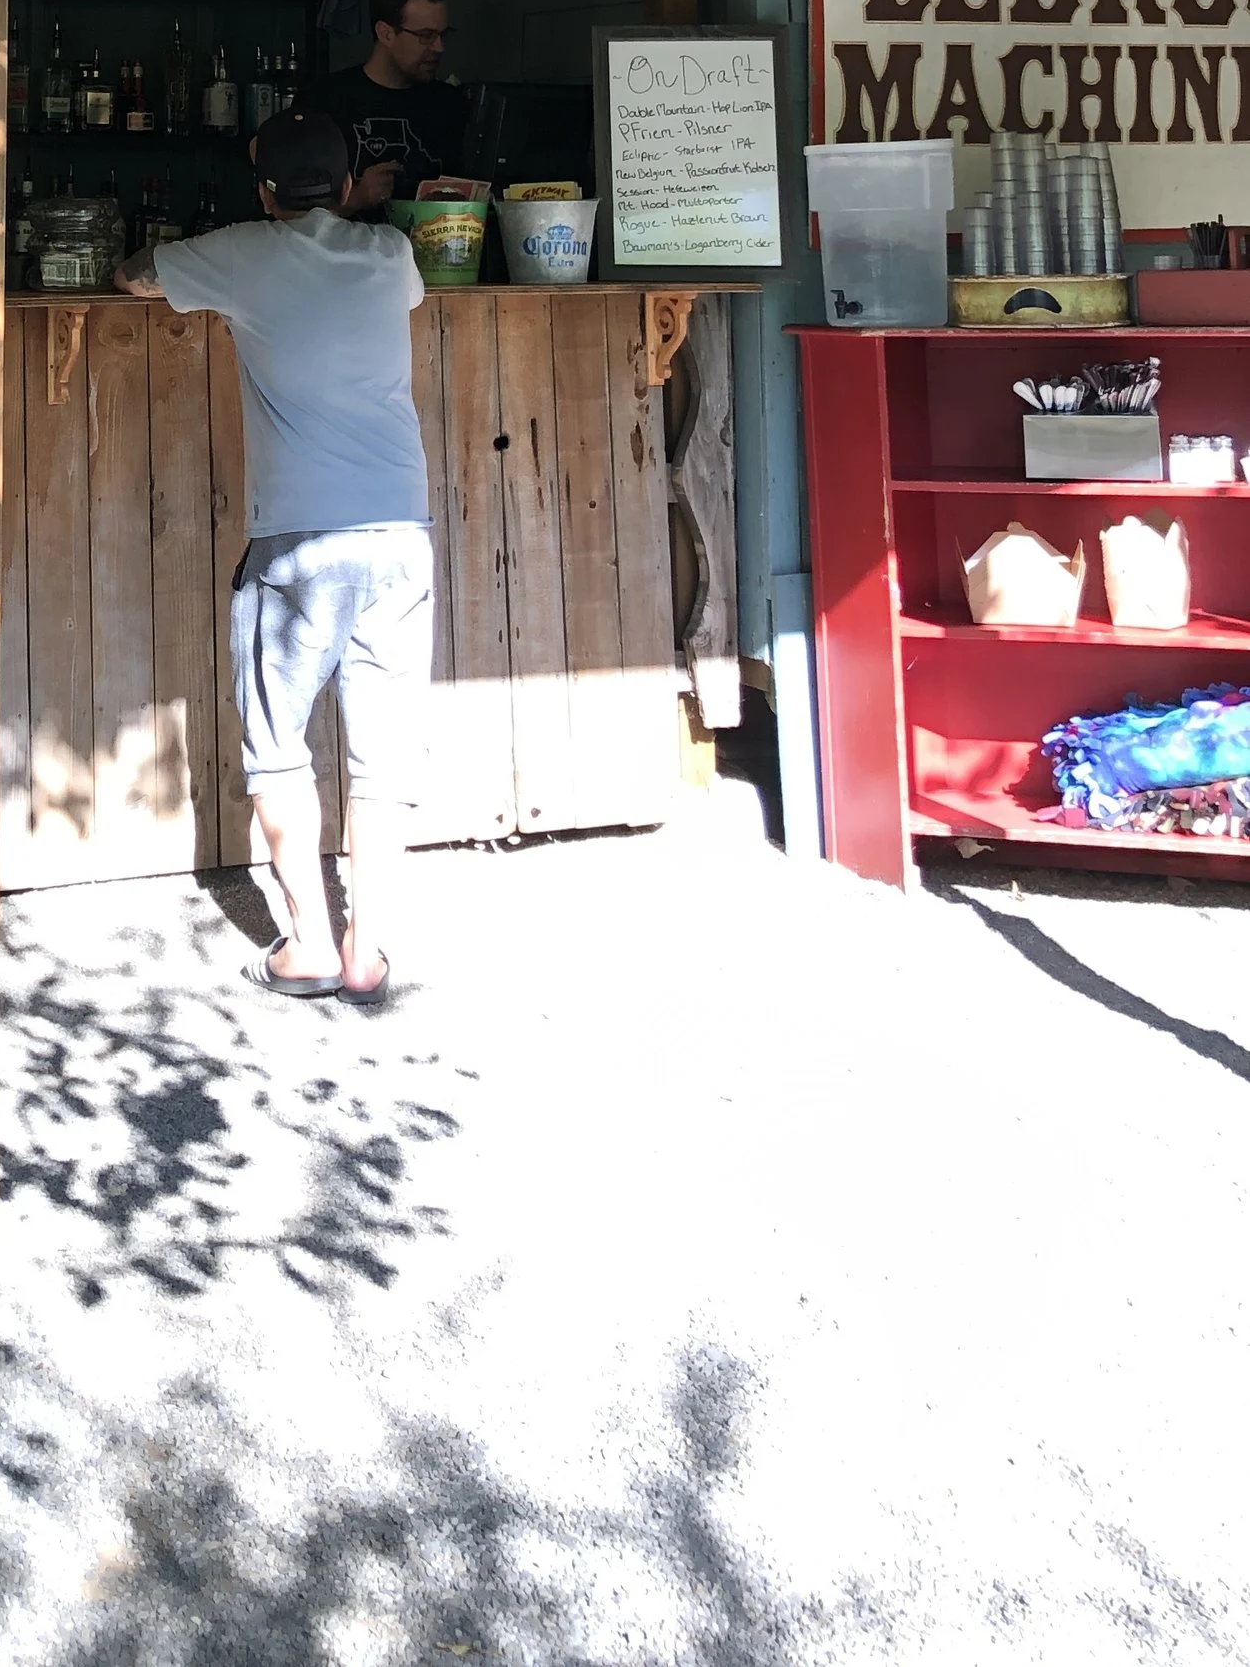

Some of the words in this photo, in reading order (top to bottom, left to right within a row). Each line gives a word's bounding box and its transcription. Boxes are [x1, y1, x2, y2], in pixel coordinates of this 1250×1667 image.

[628, 55, 678, 94] On
[679, 54, 760, 95] Draft
[618, 105, 655, 119] Double
[656, 103, 706, 116] Mountain
[754, 100, 772, 112] IPA
[683, 119, 733, 136] Pilsner
[731, 137, 756, 150] IPA
[637, 168, 677, 181] Belgium
[617, 187, 655, 198] Session
[640, 198, 670, 210] Hood
[619, 215, 661, 235] Rogue
[730, 212, 769, 224] Brown
[421, 225, 456, 238] SIERRA
[522, 235, 588, 258] Corona
[746, 237, 775, 248] Cider
